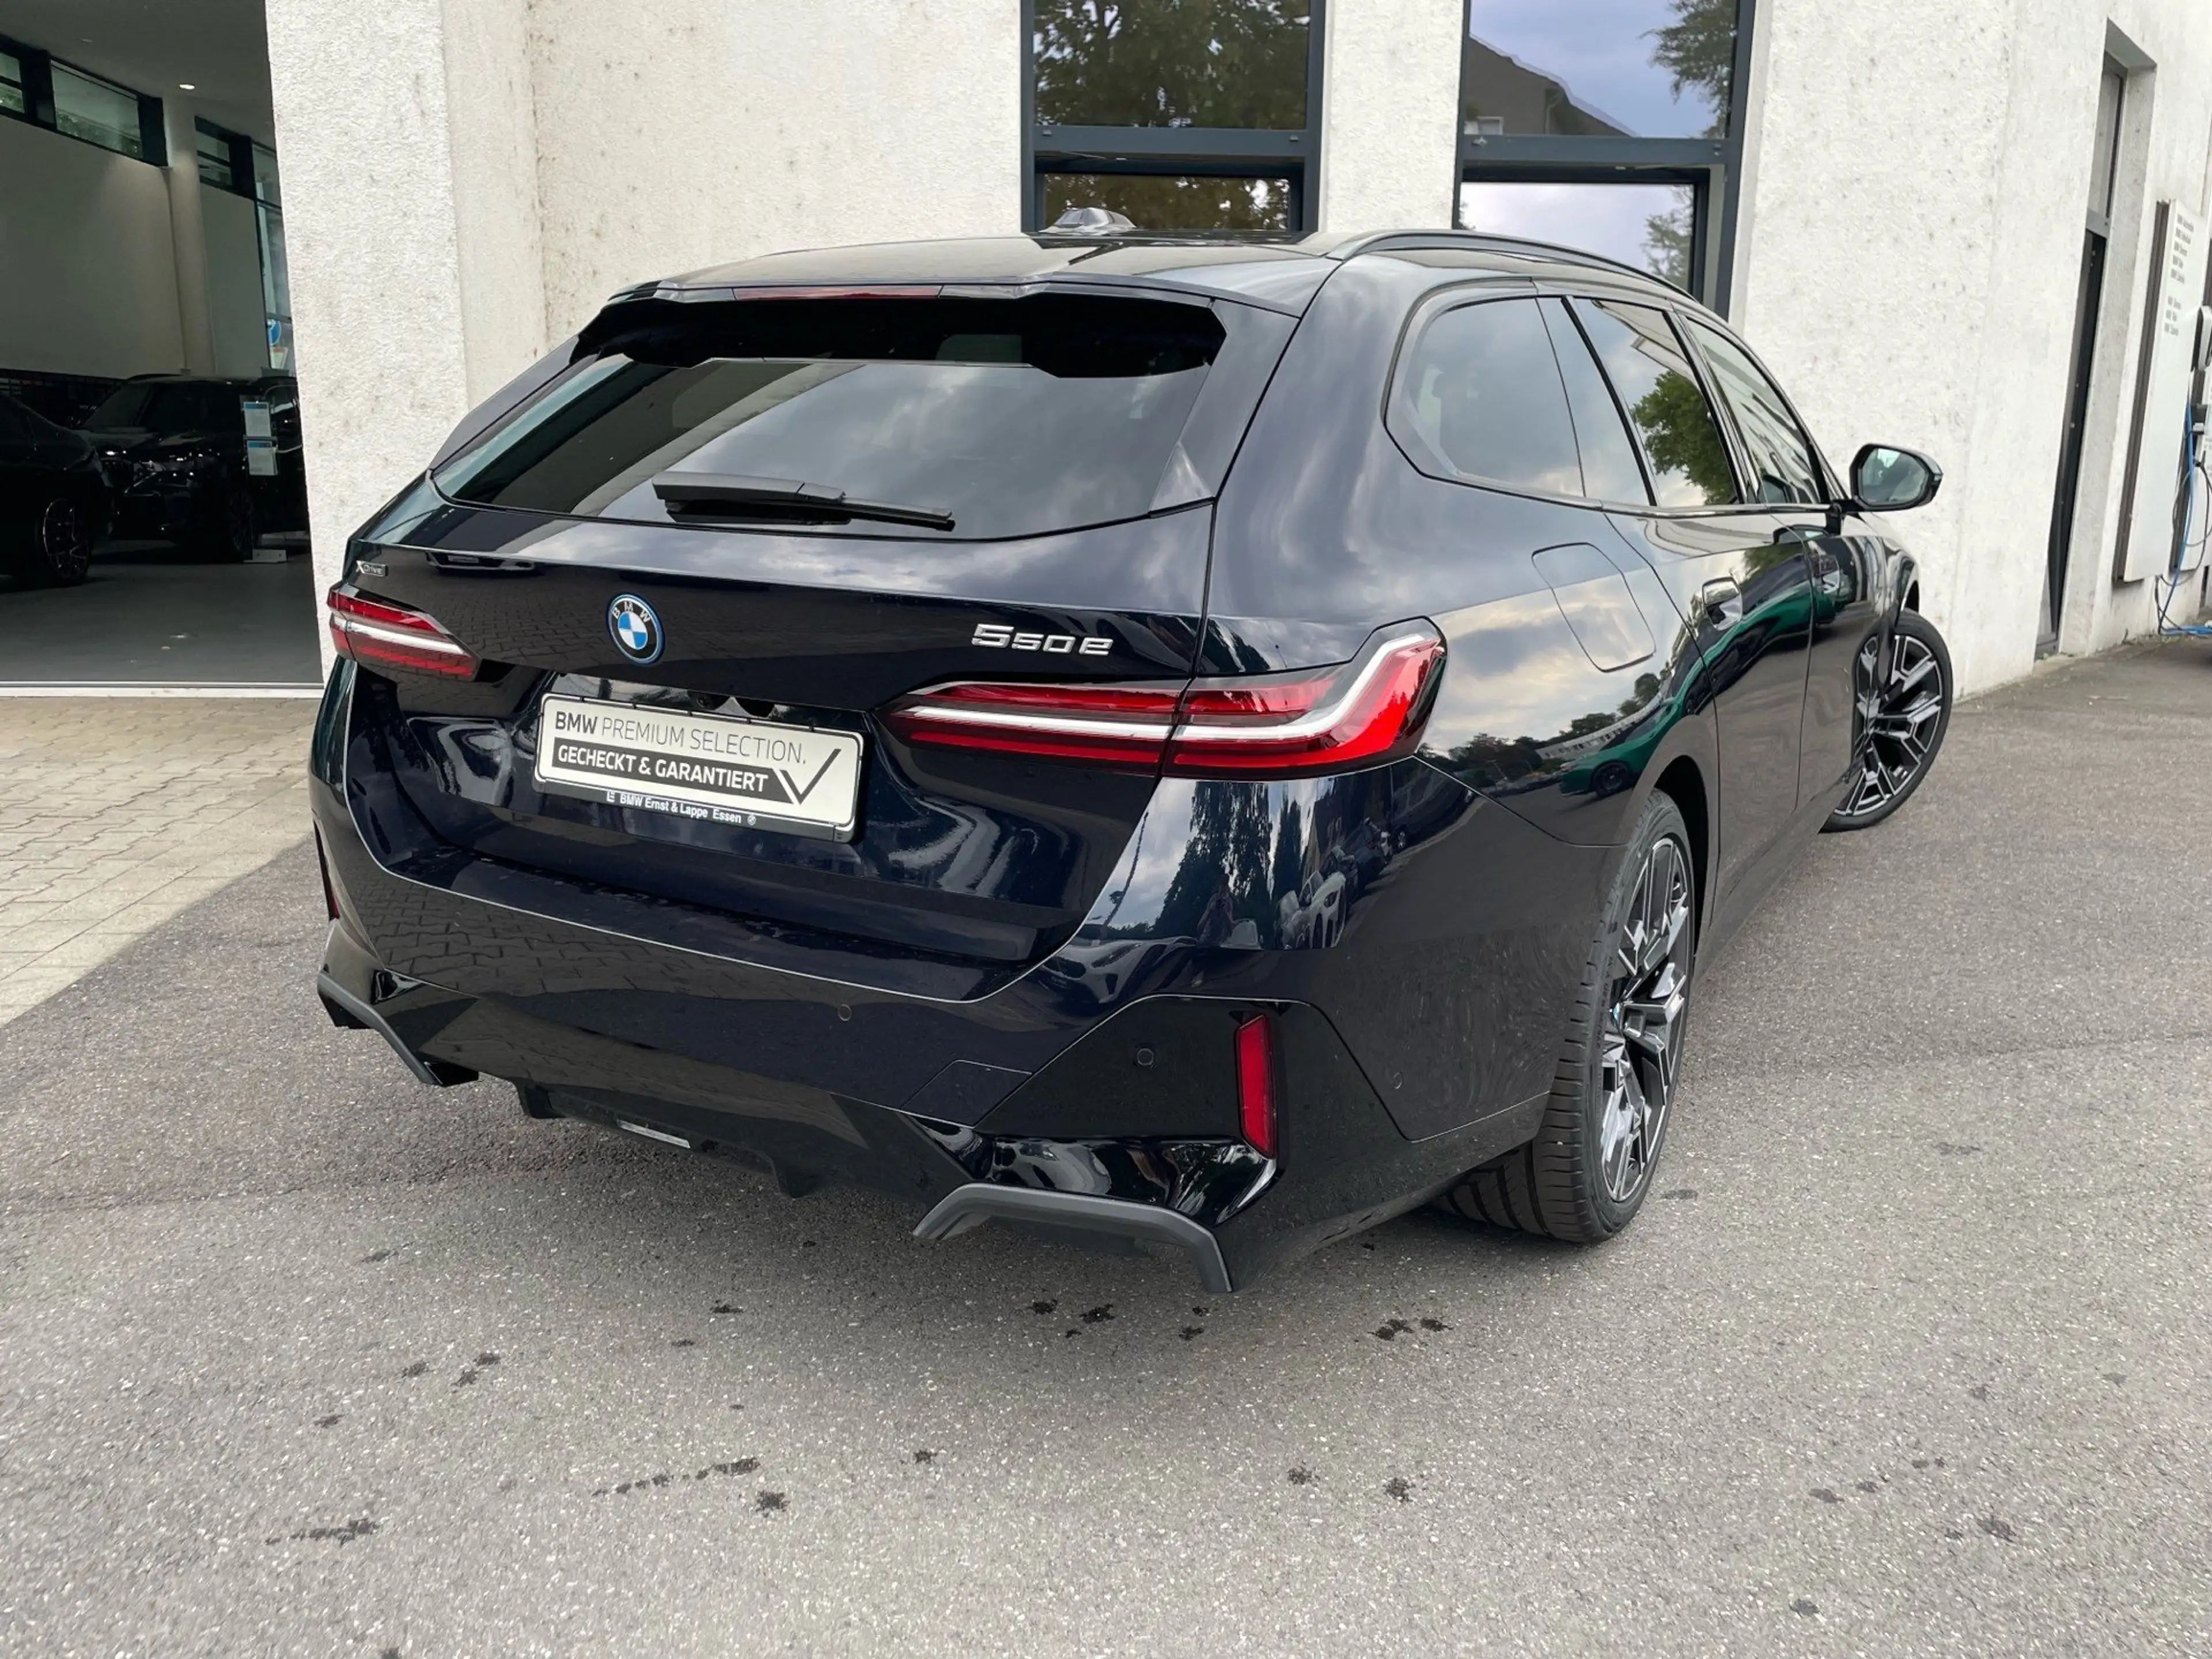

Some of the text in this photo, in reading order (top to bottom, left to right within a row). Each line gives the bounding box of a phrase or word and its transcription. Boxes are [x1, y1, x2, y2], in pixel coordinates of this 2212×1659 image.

[612, 601, 651, 623] BMW
[555, 711, 806, 764] BMW PREMIUM SELECTION.
[558, 745, 769, 793] GECHECKT & GARANTIERT
[620, 793, 643, 806] BMW
[645, 797, 669, 811] Ernst
[671, 802, 679, 813] &
[680, 803, 709, 819] Lappe
[712, 809, 742, 824] Essen
